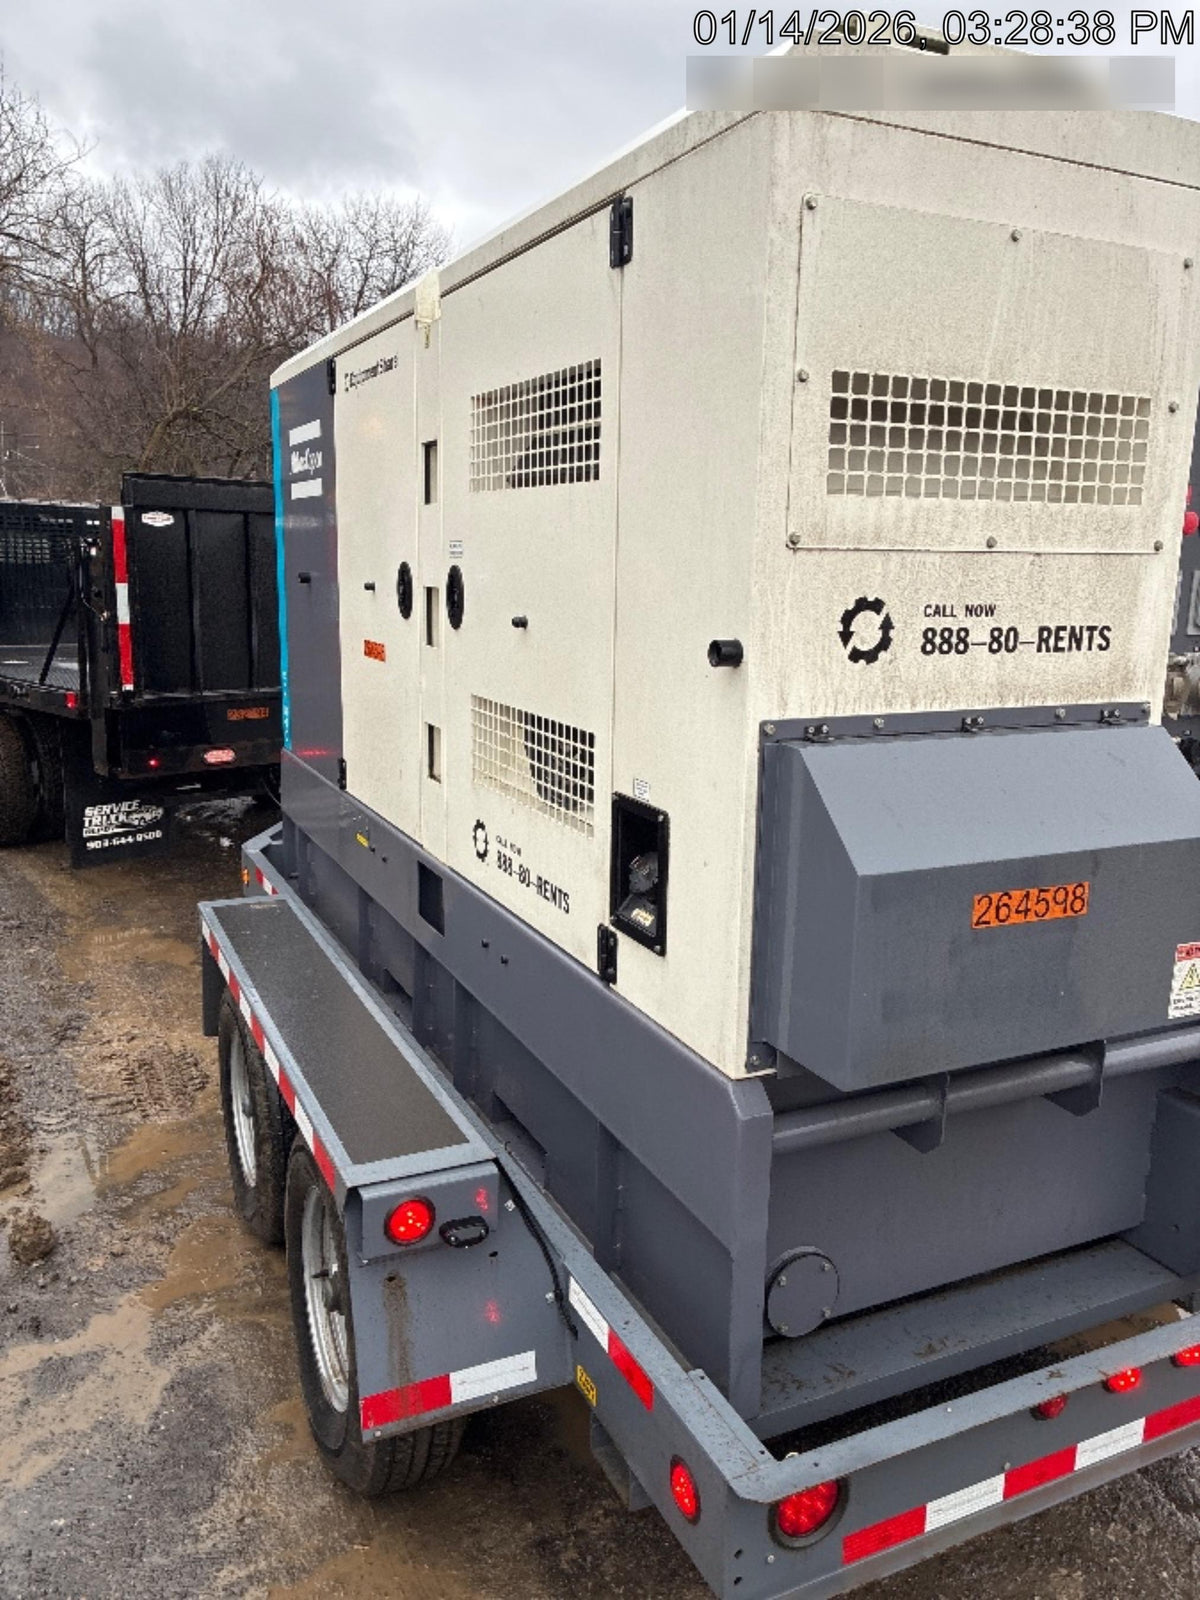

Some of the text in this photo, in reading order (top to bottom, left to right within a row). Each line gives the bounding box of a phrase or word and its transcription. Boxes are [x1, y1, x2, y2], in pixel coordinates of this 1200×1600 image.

[923, 604, 997, 618] CALL NOW
[920, 625, 1112, 656] 888-80-RENTS
[84, 799, 141, 817] SERVICE
[973, 882, 1087, 927] 264598
